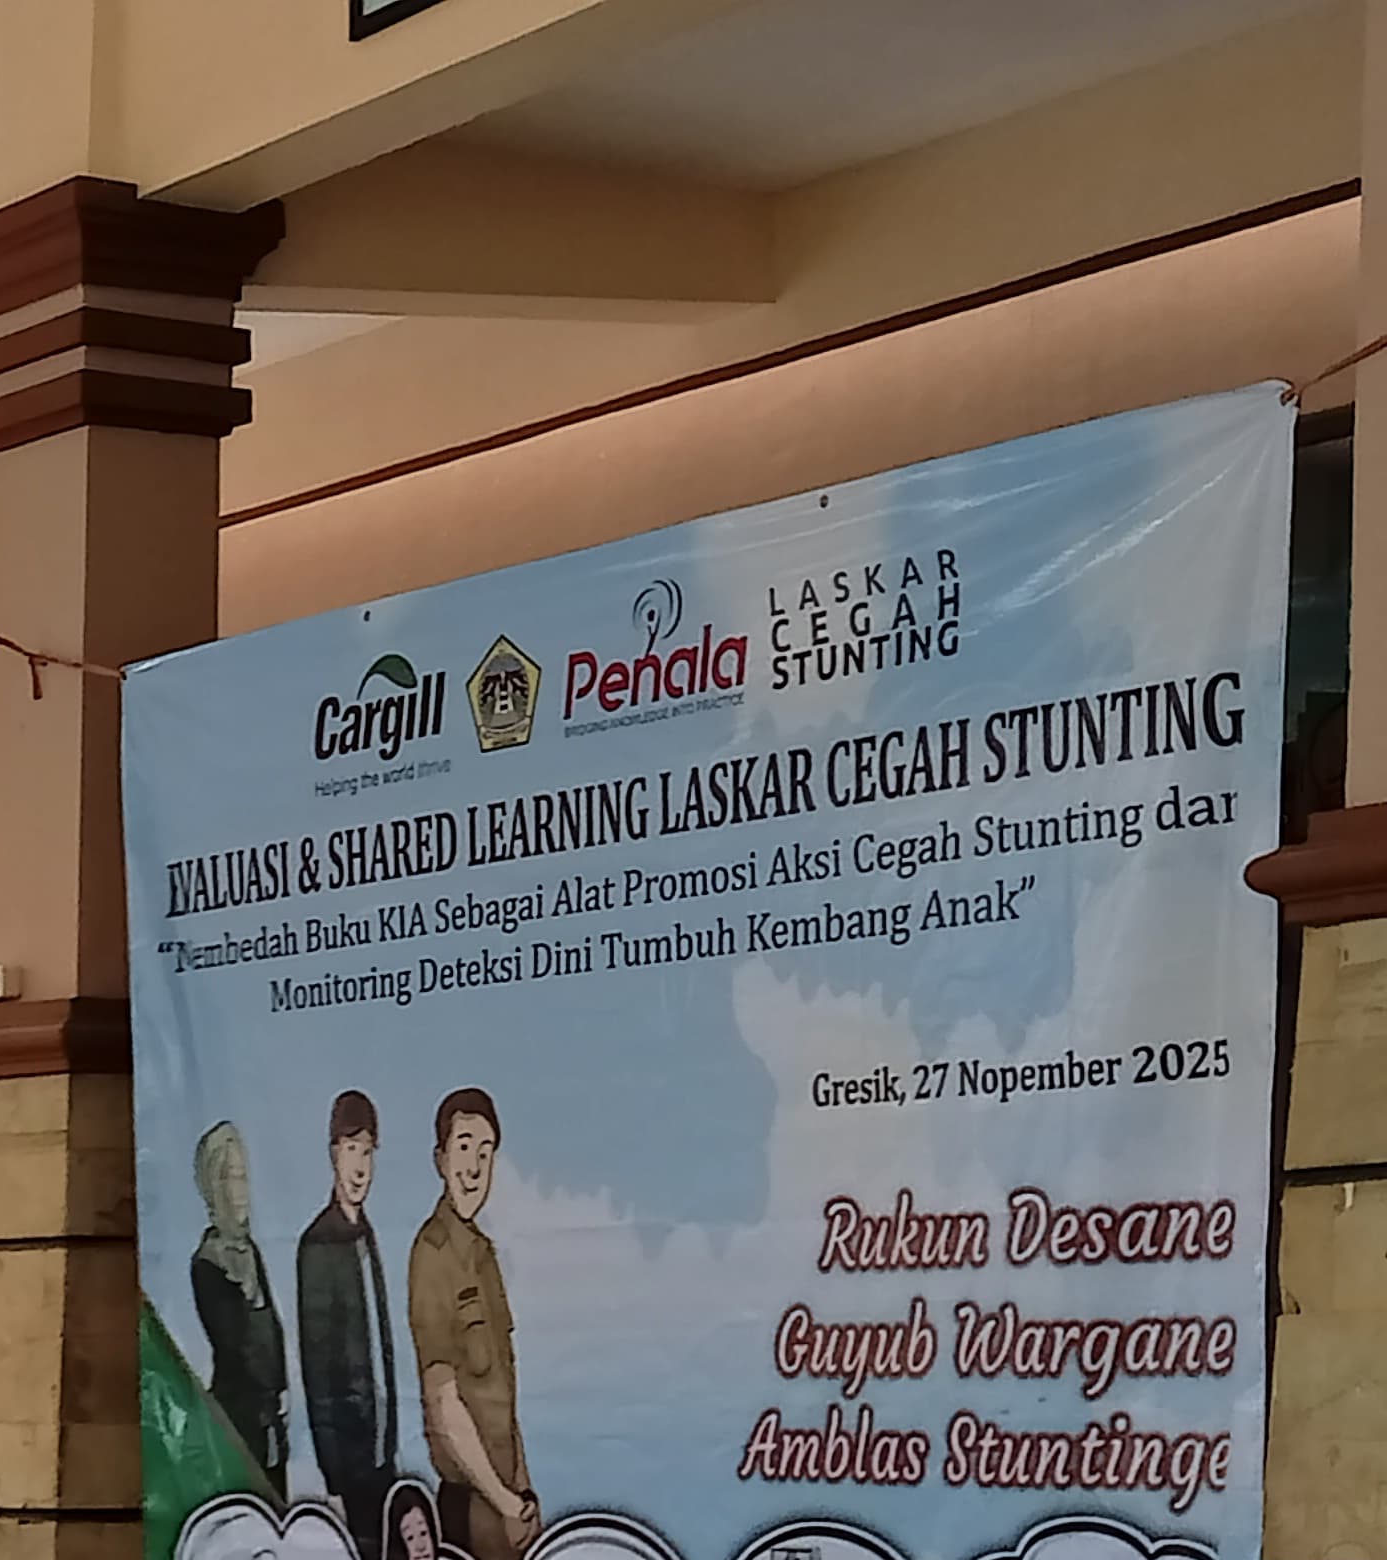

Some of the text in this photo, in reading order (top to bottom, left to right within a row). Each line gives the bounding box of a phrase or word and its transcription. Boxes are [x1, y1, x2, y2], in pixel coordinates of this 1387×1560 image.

[769, 549, 958, 617] LASKAR
[771, 582, 960, 652] CEGAH
[563, 624, 748, 720] Penala
[772, 620, 959, 690] STUNTING
[315, 671, 445, 760] Cargill
[298, 837, 321, 894] &
[328, 812, 457, 889] SHARED
[467, 777, 650, 867] LEARNING
[659, 748, 816, 835] LASKAR
[827, 718, 970, 808] CEGAH
[983, 672, 1245, 783] STUNTING
[361, 771, 378, 788] the
[306, 913, 371, 953] Buku
[378, 902, 427, 942] KIA
[435, 885, 543, 934] Sebagai
[551, 876, 615, 917] Alat
[623, 852, 758, 907] Promosi
[766, 839, 842, 886] Aksi
[853, 821, 962, 879] Cegah
[974, 801, 1144, 857] Stunting
[270, 967, 412, 1012] Monitoring
[419, 947, 522, 993] Deteksi
[531, 937, 592, 979] Dini
[601, 917, 735, 970] Tumbuh
[748, 902, 911, 952] Kembang
[812, 1039, 1230, 1107] Gresik, 27 Nopember 2025
[819, 1186, 1235, 1273] Rukun Desane
[774, 1296, 1236, 1399] Guyub Wargane
[737, 1403, 1231, 1515] Amblas Stuntinge
